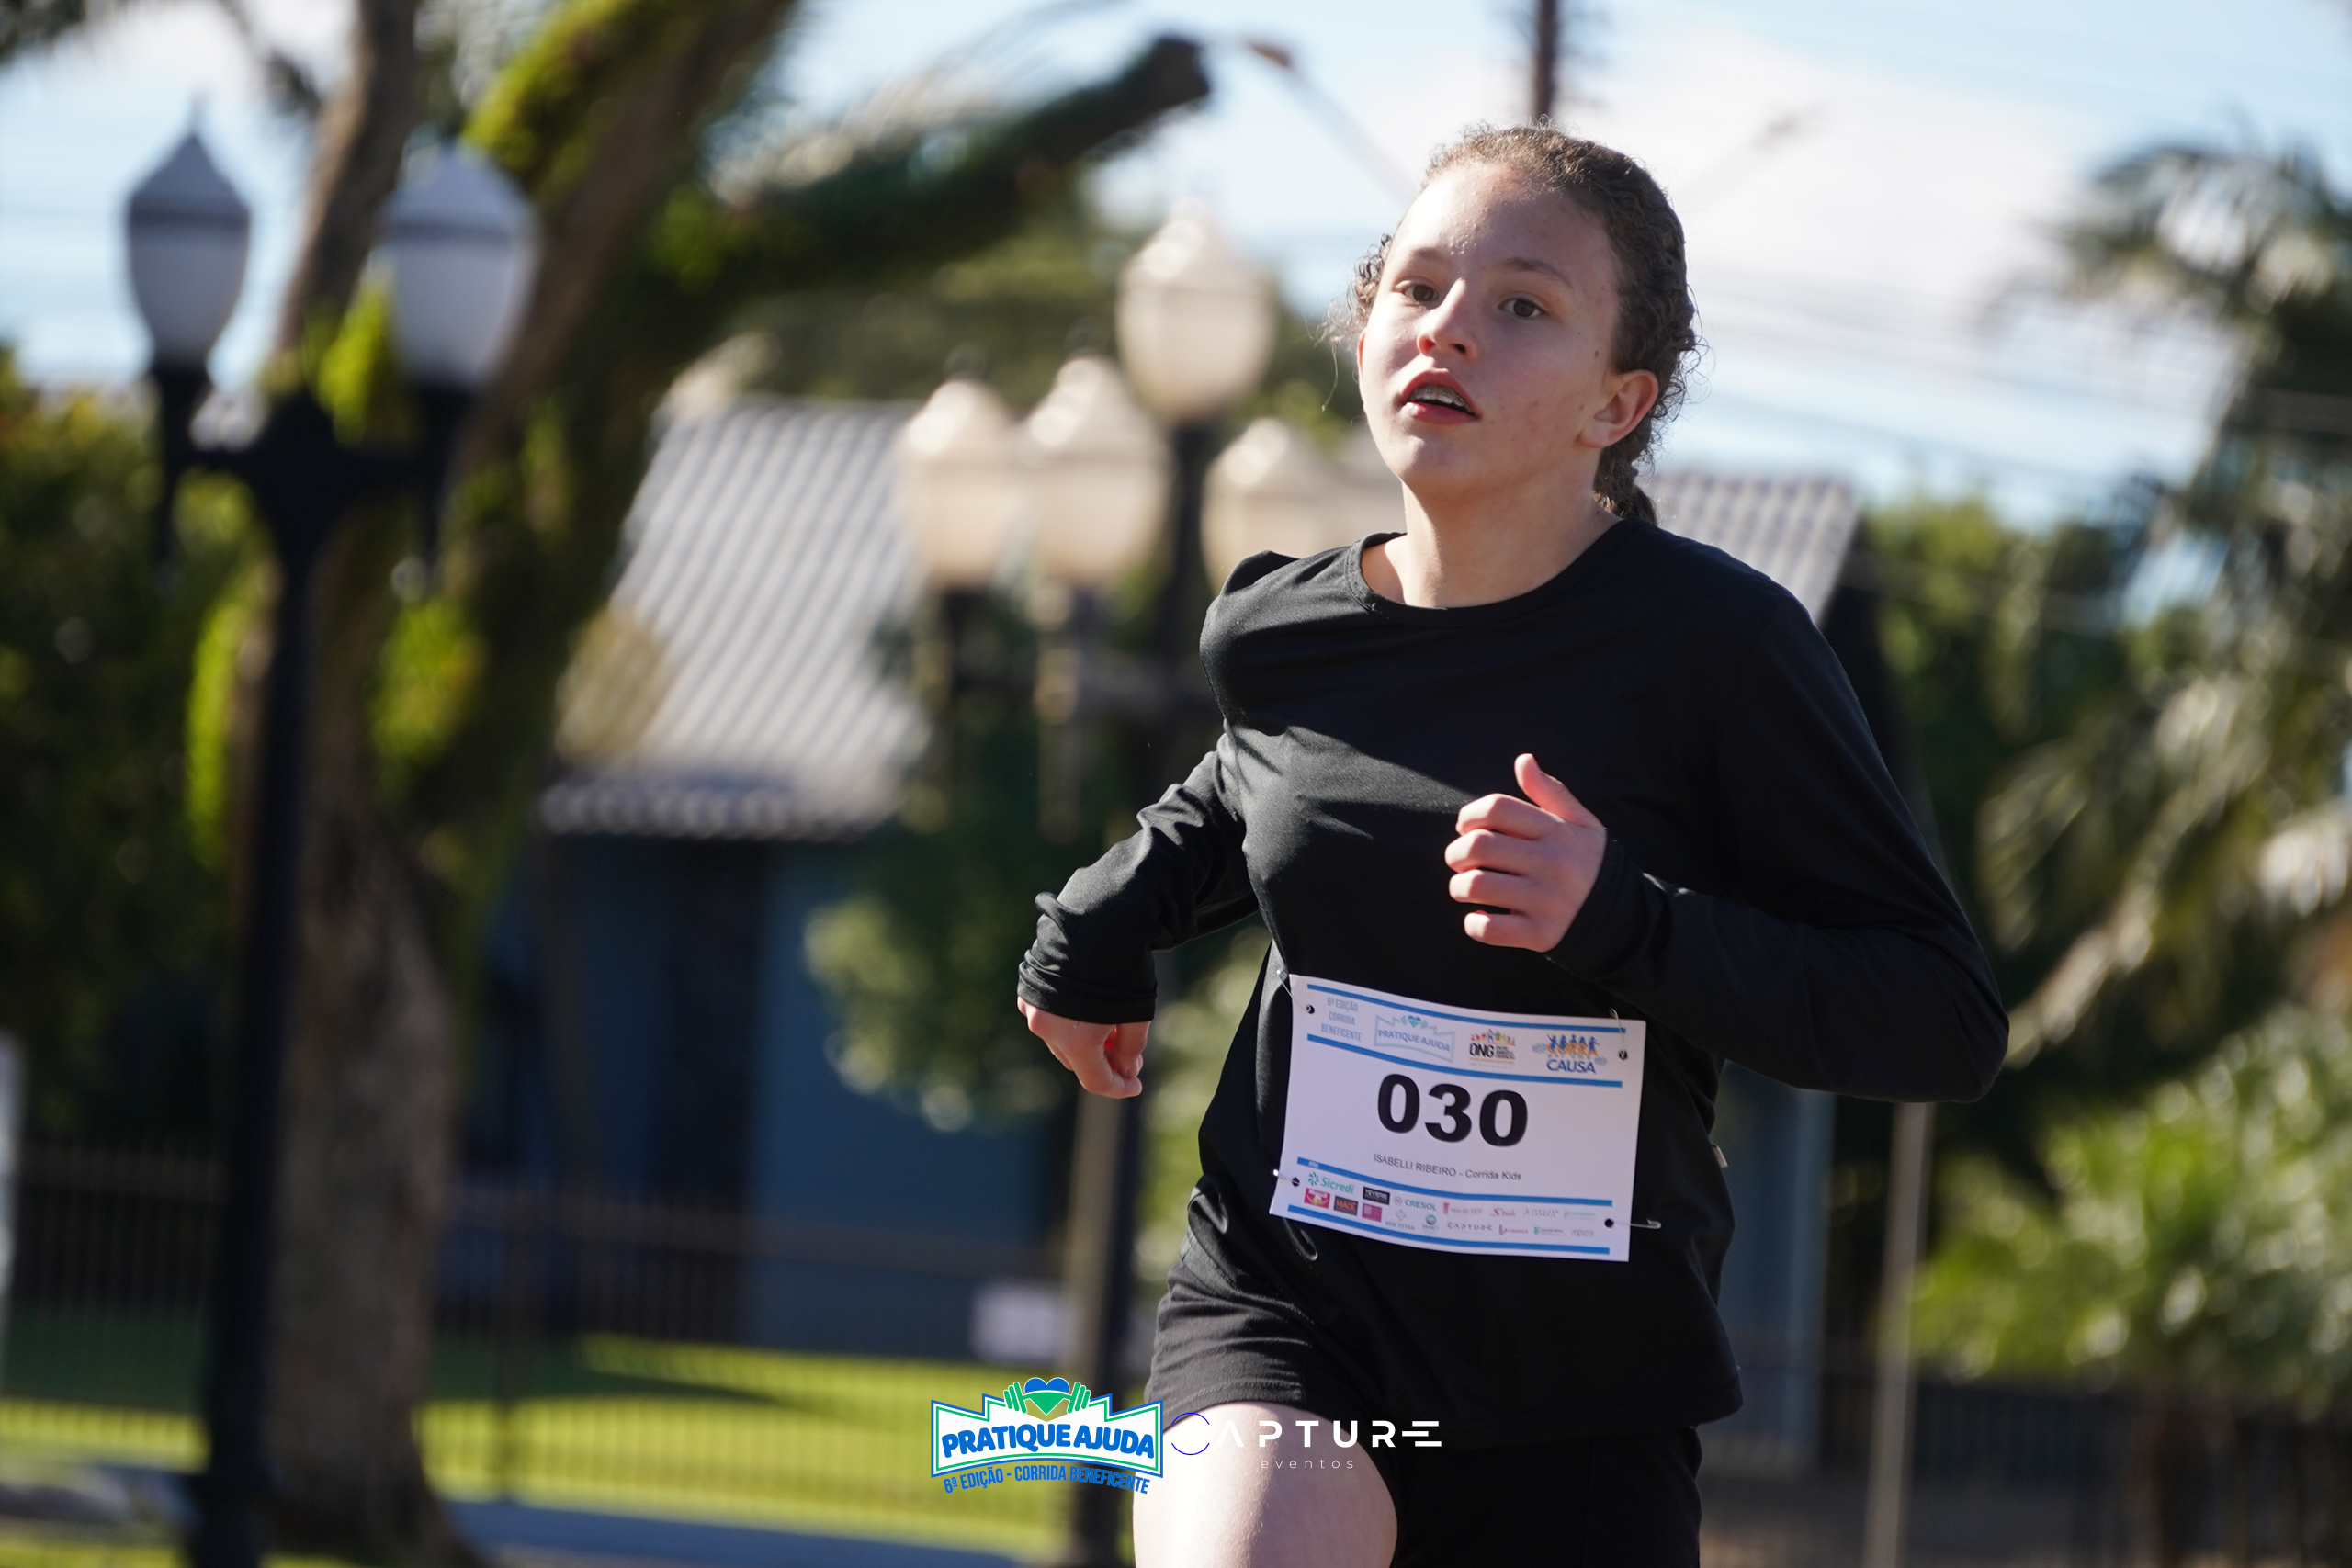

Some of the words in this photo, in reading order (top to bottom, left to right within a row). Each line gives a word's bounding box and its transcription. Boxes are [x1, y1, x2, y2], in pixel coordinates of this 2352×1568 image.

[1336, 999, 1359, 1012] EDIÇÃO
[1329, 1011, 1355, 1026] CORRIDA
[1320, 1022, 1362, 1043] BENEFICENTE
[1378, 1029, 1419, 1044] PRATIQUE
[1420, 1037, 1451, 1053] AJUDA
[1470, 1043, 1495, 1058] ONG
[1546, 1059, 1597, 1074] CAUSA
[1377, 1073, 1528, 1147] 030
[1374, 1153, 1414, 1171] ISABELLI
[1415, 1163, 1457, 1178] RIBEIRO
[1465, 1168, 1499, 1180] Corrida
[1501, 1171, 1522, 1181] Kids
[1321, 1177, 1355, 1195] Sicredi
[1404, 1199, 1437, 1211] CRESOL
[1447, 1222, 1493, 1231] CAPTURE
